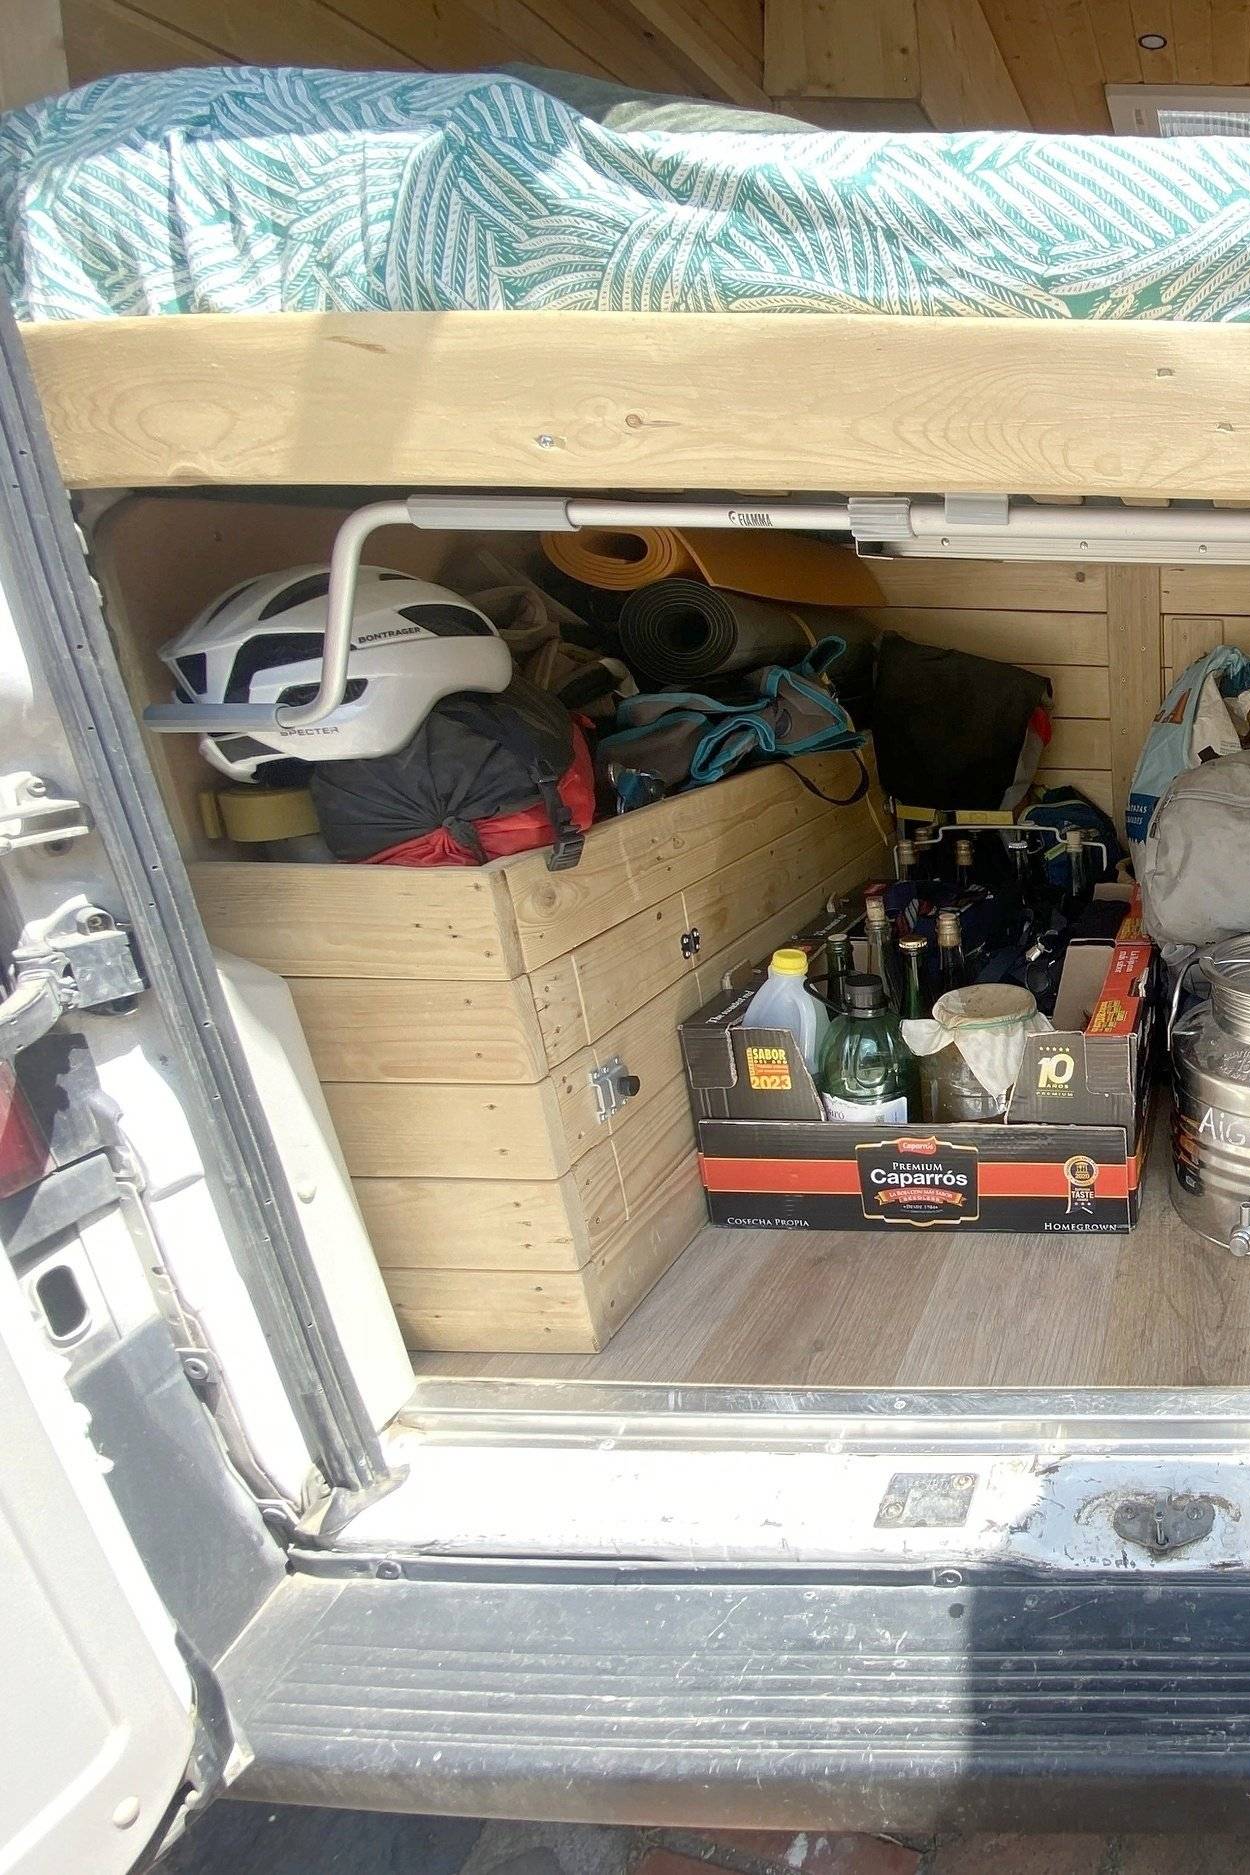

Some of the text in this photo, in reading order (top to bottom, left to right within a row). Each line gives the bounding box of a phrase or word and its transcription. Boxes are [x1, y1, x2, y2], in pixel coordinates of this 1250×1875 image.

[737, 513, 773, 526] FIAMMA
[358, 627, 421, 644] BONTRAGER
[752, 1048, 787, 1061] SABOR
[1038, 1053, 1075, 1088] 10
[892, 1162, 943, 1171] PREMIUM
[870, 1168, 968, 1187] Caparrós
[1071, 1191, 1095, 1199] TASTE
[727, 1217, 810, 1227] COSECHA PROPIA
[1044, 1222, 1117, 1232] HOMEGROWN
